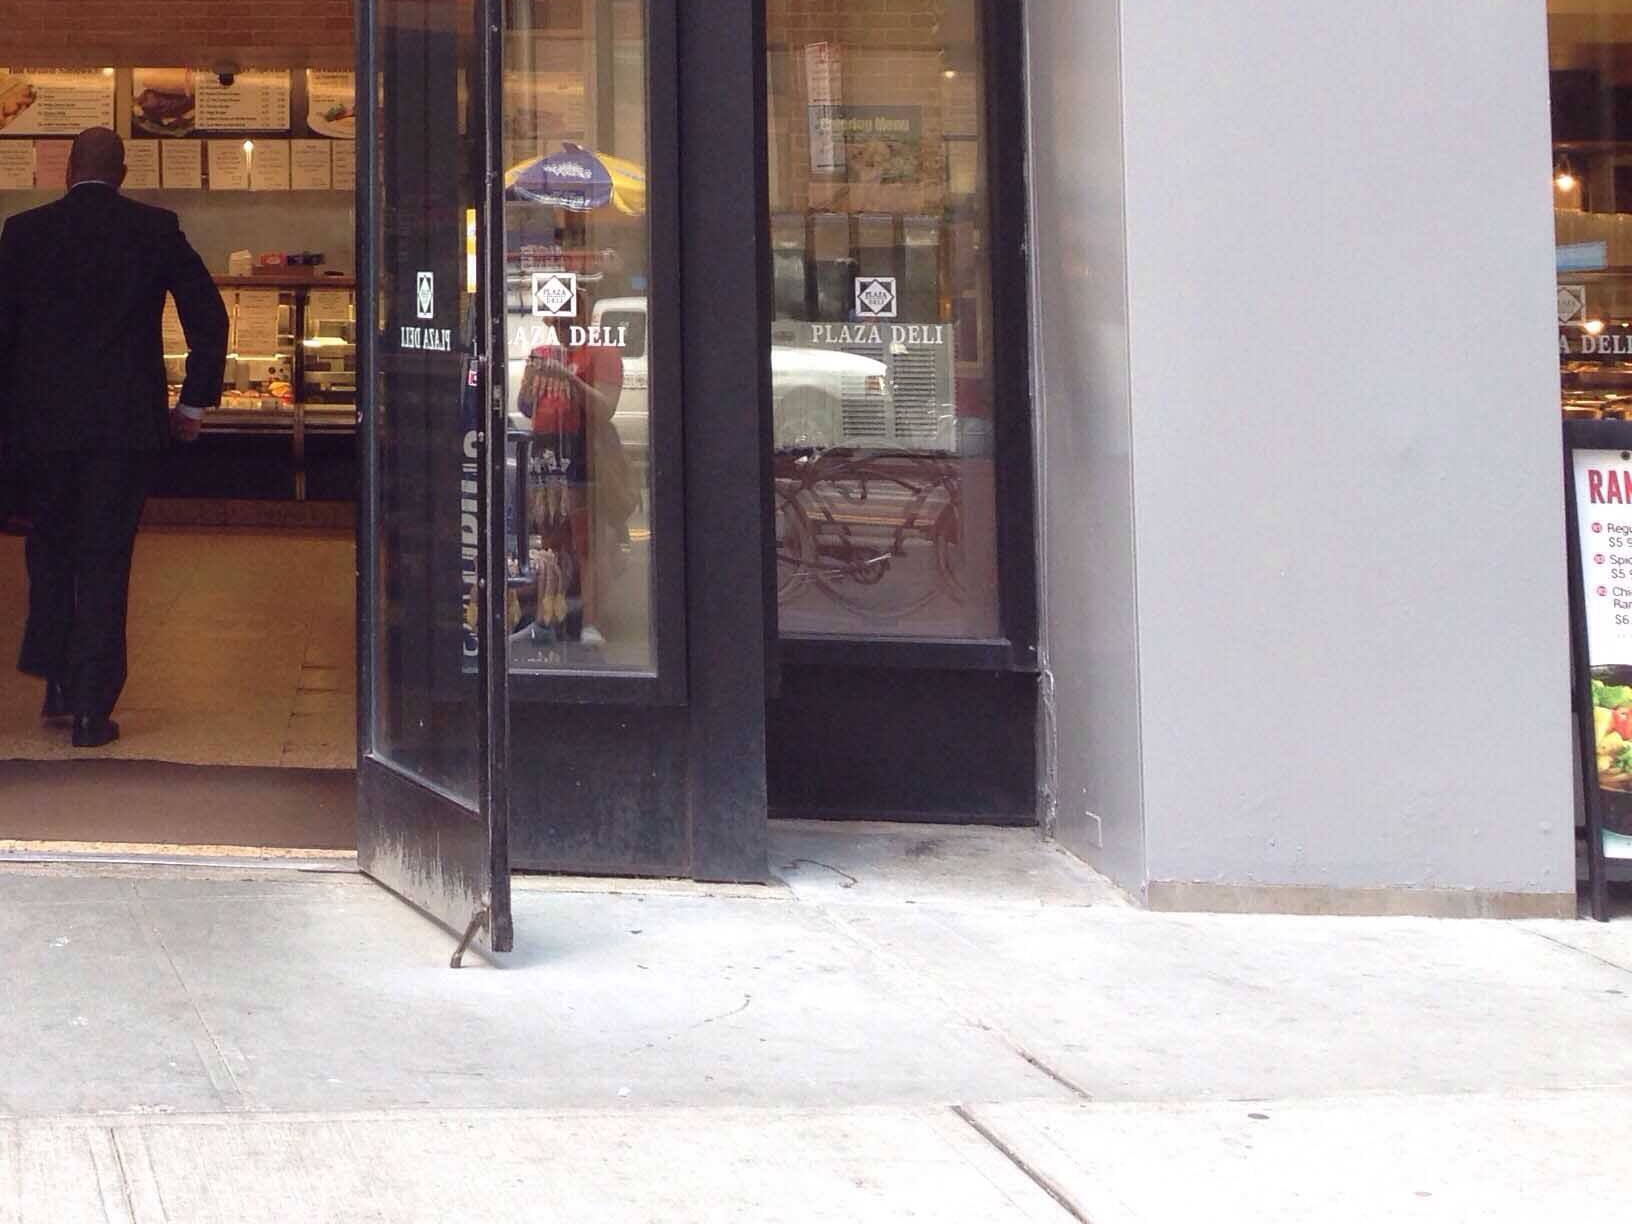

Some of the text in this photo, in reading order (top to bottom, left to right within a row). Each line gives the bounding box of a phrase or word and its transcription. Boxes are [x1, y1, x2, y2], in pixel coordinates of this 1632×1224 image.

[544, 288, 567, 296] PLAZA
[865, 291, 887, 299] PLAZA
[569, 326, 626, 347] DELI
[811, 325, 944, 344] PLAZA DELI
